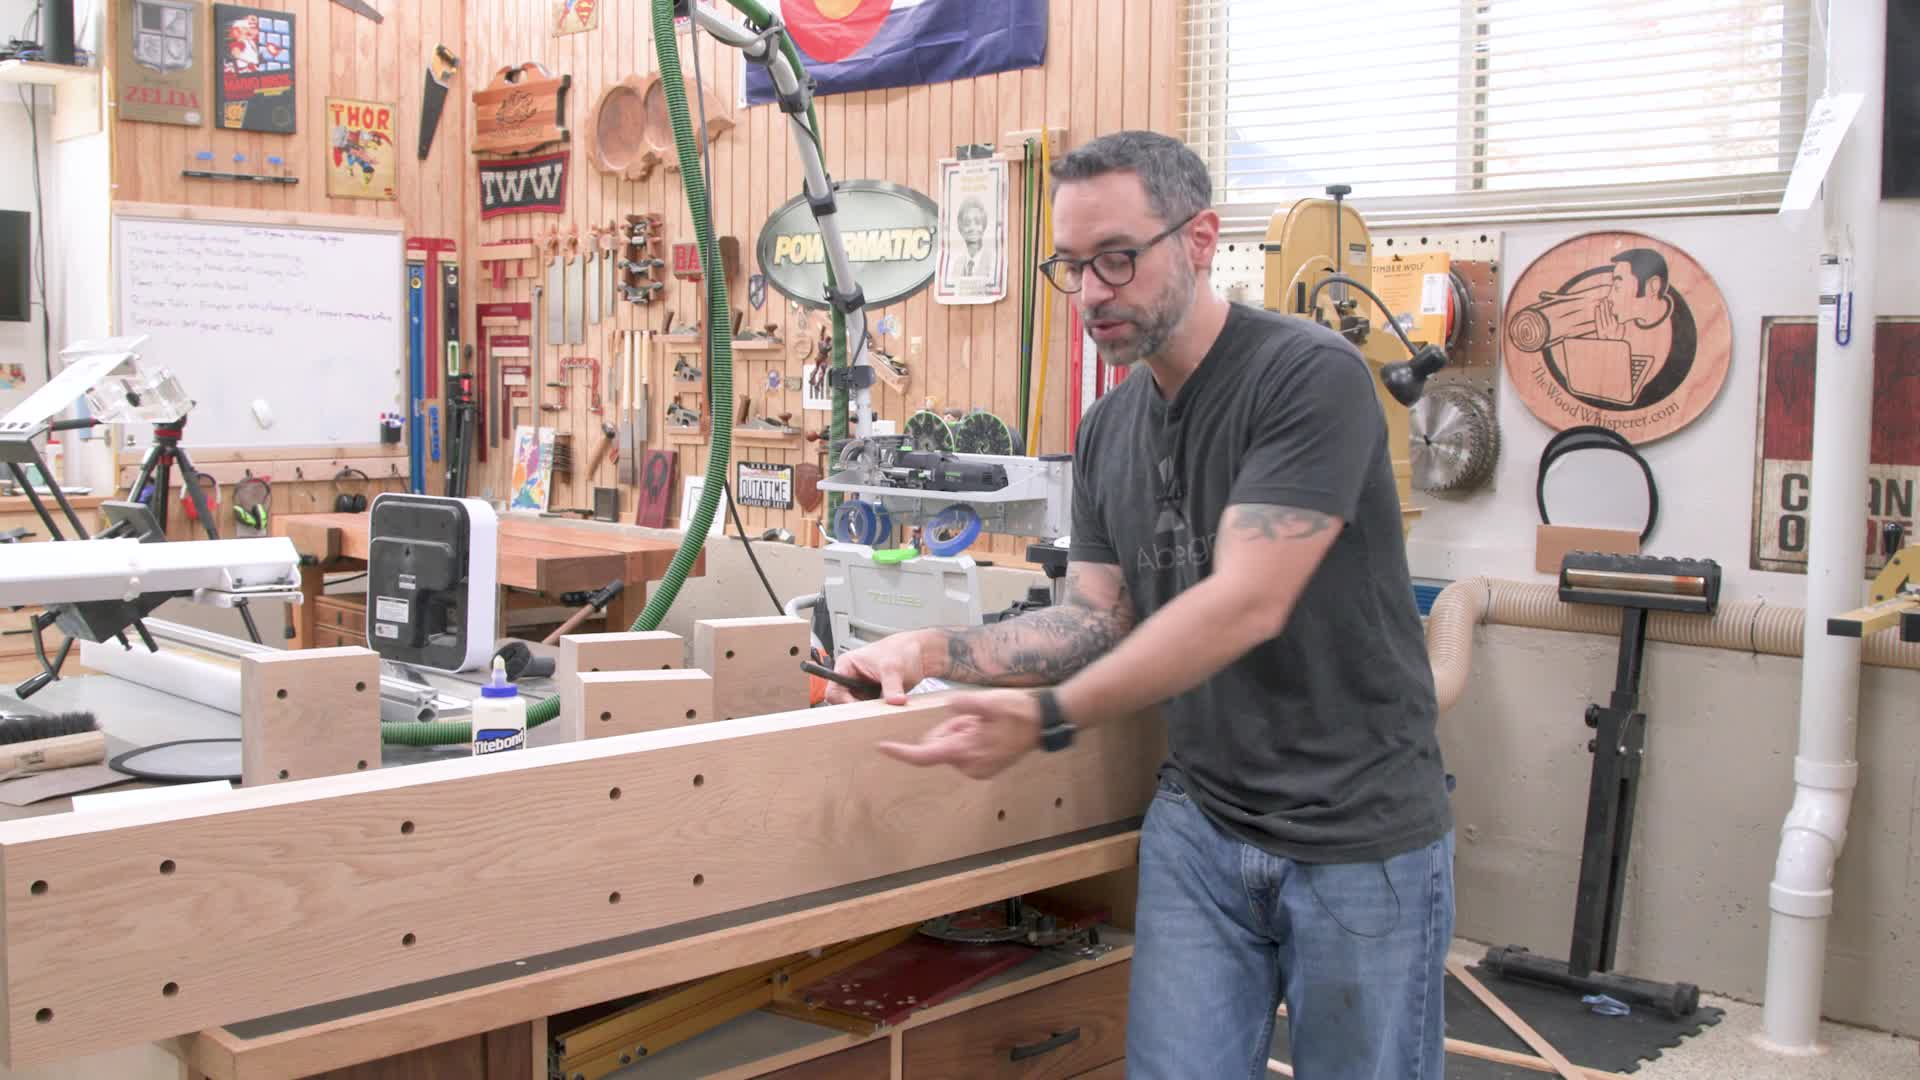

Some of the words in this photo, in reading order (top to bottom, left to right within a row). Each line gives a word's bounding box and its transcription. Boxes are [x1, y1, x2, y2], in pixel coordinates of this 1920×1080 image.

[124, 86, 200, 108] ZELDA
[329, 103, 390, 130] THOR
[481, 162, 563, 205] TWW
[774, 227, 932, 266] POWRMATIC
[1371, 264, 1402, 273] TIMBER
[1404, 263, 1424, 272] WOLF
[741, 479, 787, 501] OUTATIME
[474, 729, 525, 755] Titebond
